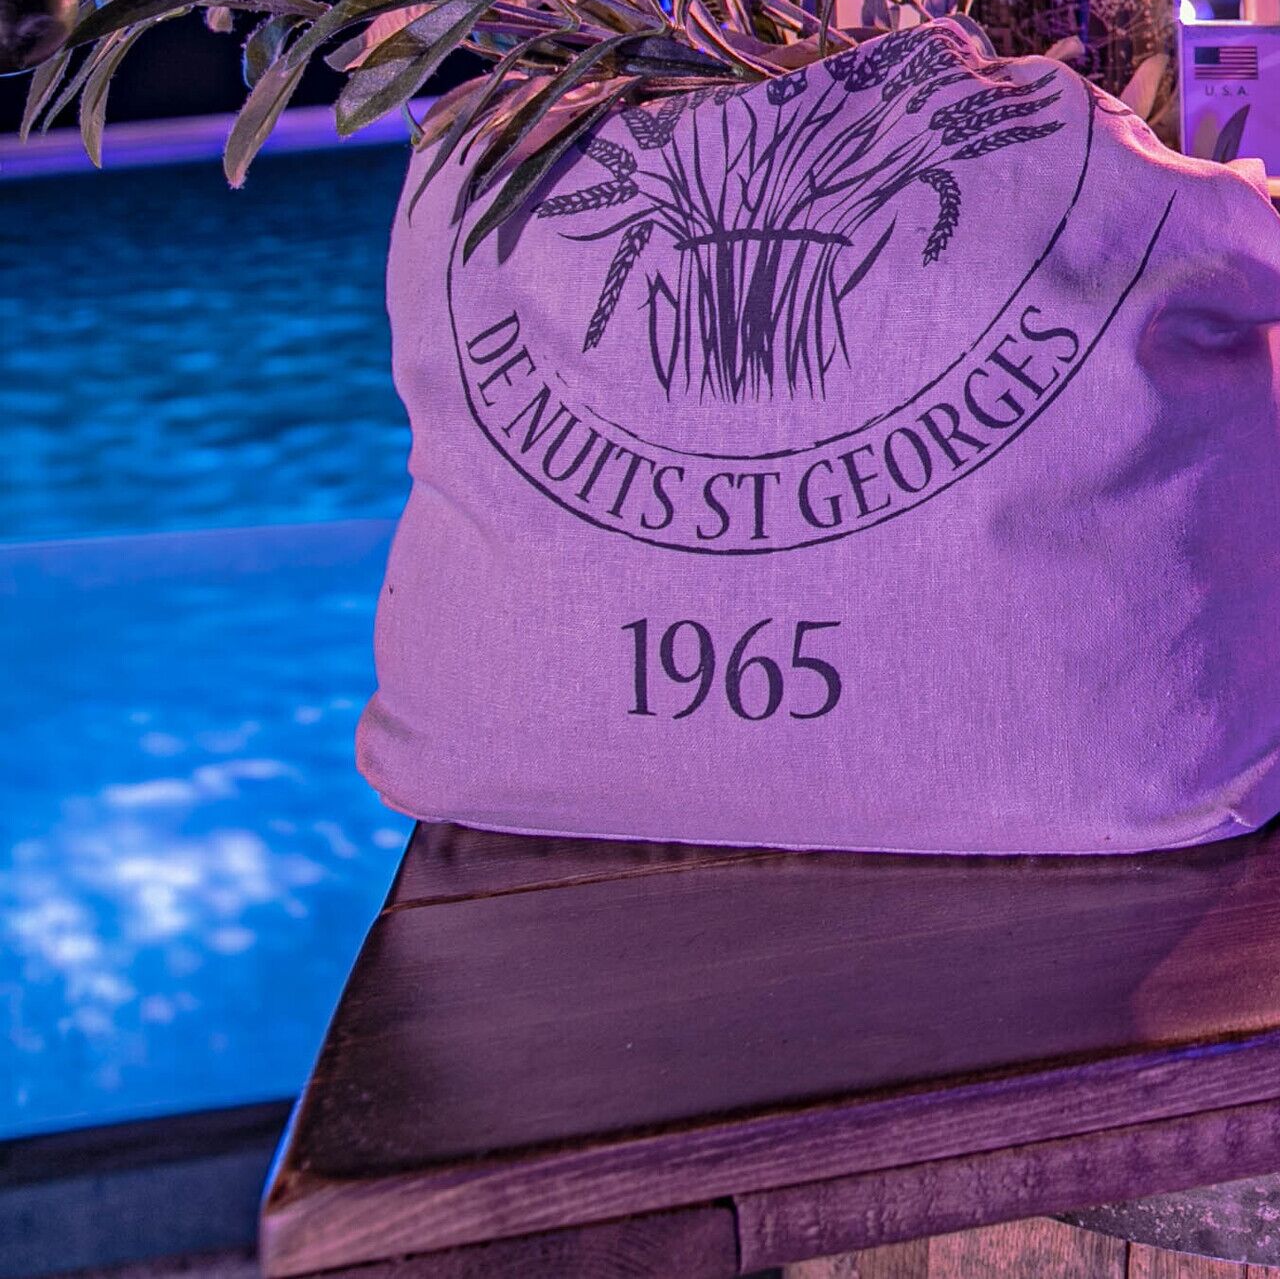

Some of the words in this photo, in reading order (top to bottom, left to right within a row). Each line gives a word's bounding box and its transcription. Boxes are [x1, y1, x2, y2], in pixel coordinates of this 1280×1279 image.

[466, 310, 536, 407] DE
[502, 382, 684, 530] NUITS
[697, 472, 780, 541] ST
[797, 304, 1080, 529] GEORGES
[621, 617, 843, 721] 1965
